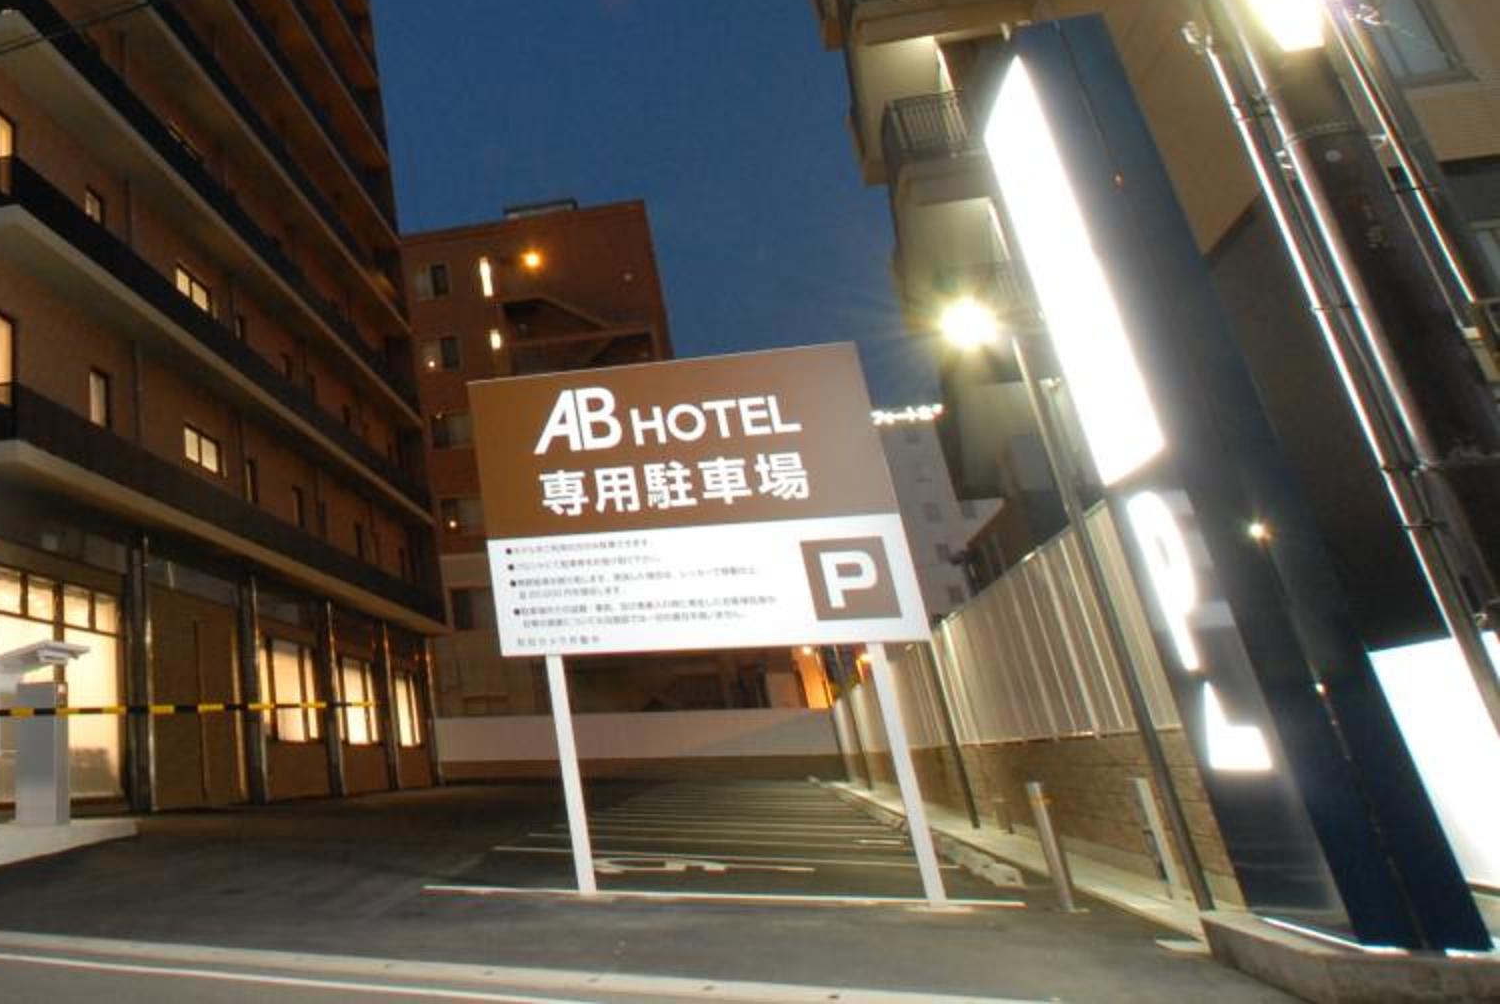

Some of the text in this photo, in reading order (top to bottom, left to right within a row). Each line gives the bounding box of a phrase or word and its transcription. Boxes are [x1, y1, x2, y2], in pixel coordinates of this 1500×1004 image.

[533, 387, 623, 455] AB
[629, 395, 803, 446] HOTEL
[538, 451, 811, 517] 専用駐車場
[818, 549, 878, 610] P
